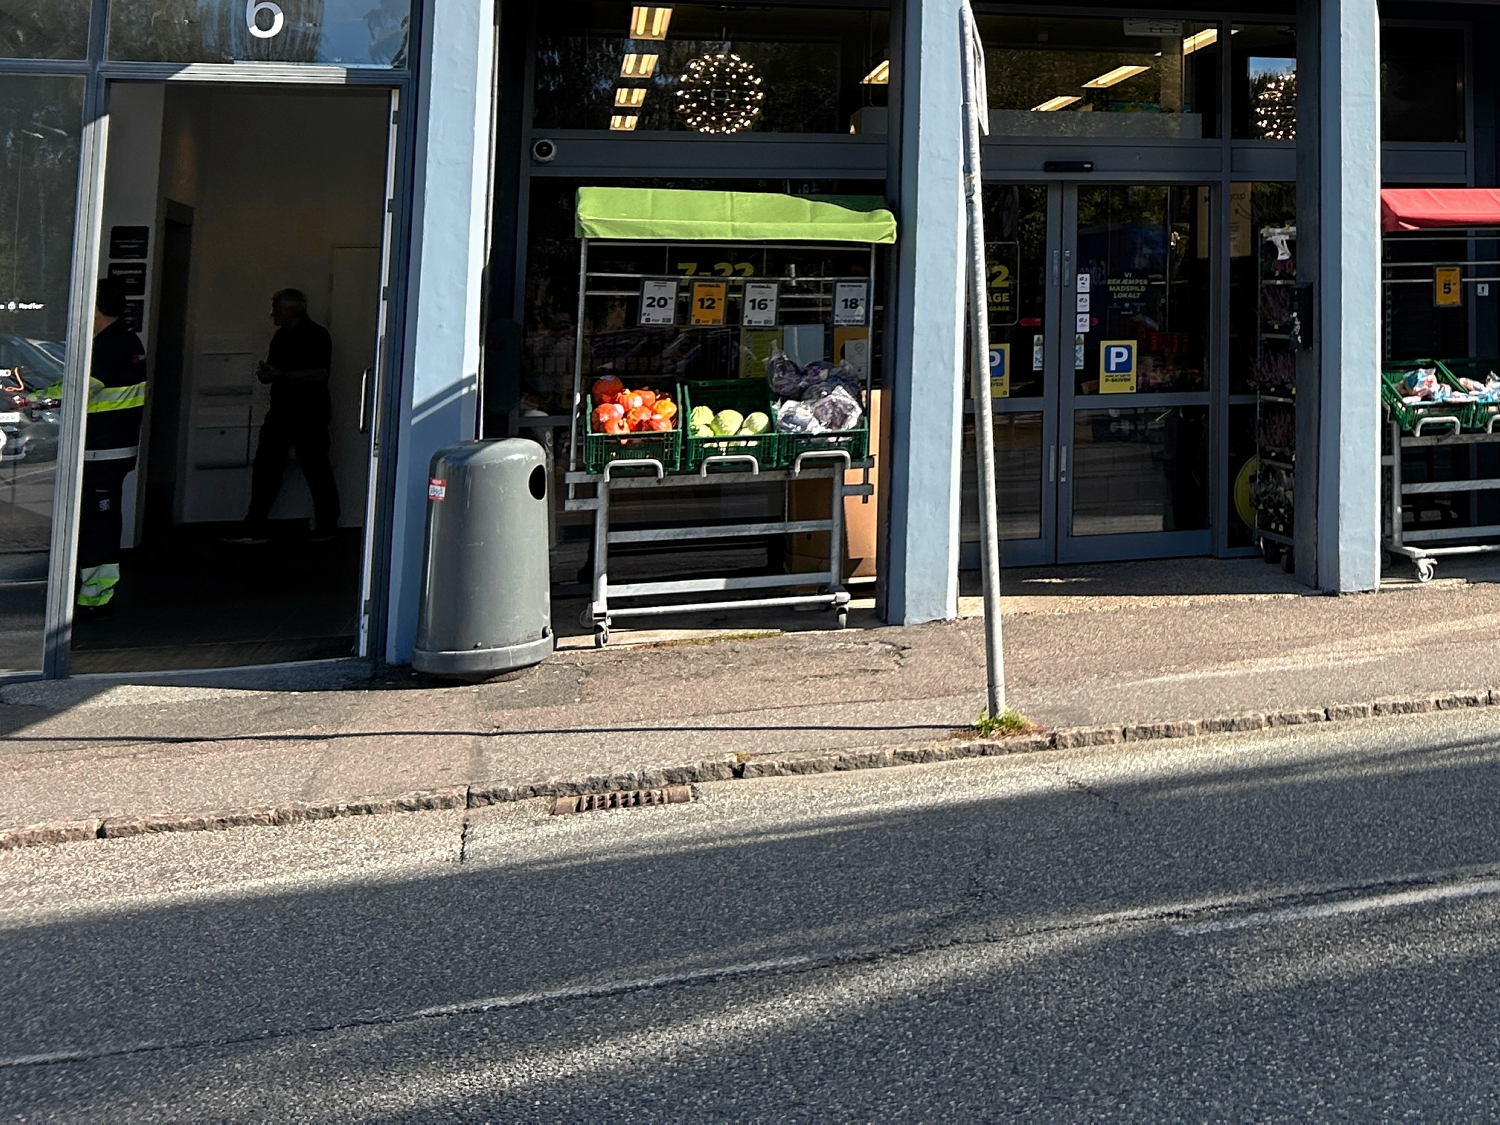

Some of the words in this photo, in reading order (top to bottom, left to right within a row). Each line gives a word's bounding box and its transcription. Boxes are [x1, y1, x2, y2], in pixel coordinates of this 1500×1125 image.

[1443, 282, 1452, 294] 5
[646, 296, 668, 308] 20
[697, 298, 716, 309] 12
[749, 298, 768, 310] 16
[842, 298, 859, 309] 18
[1110, 346, 1129, 371] P
